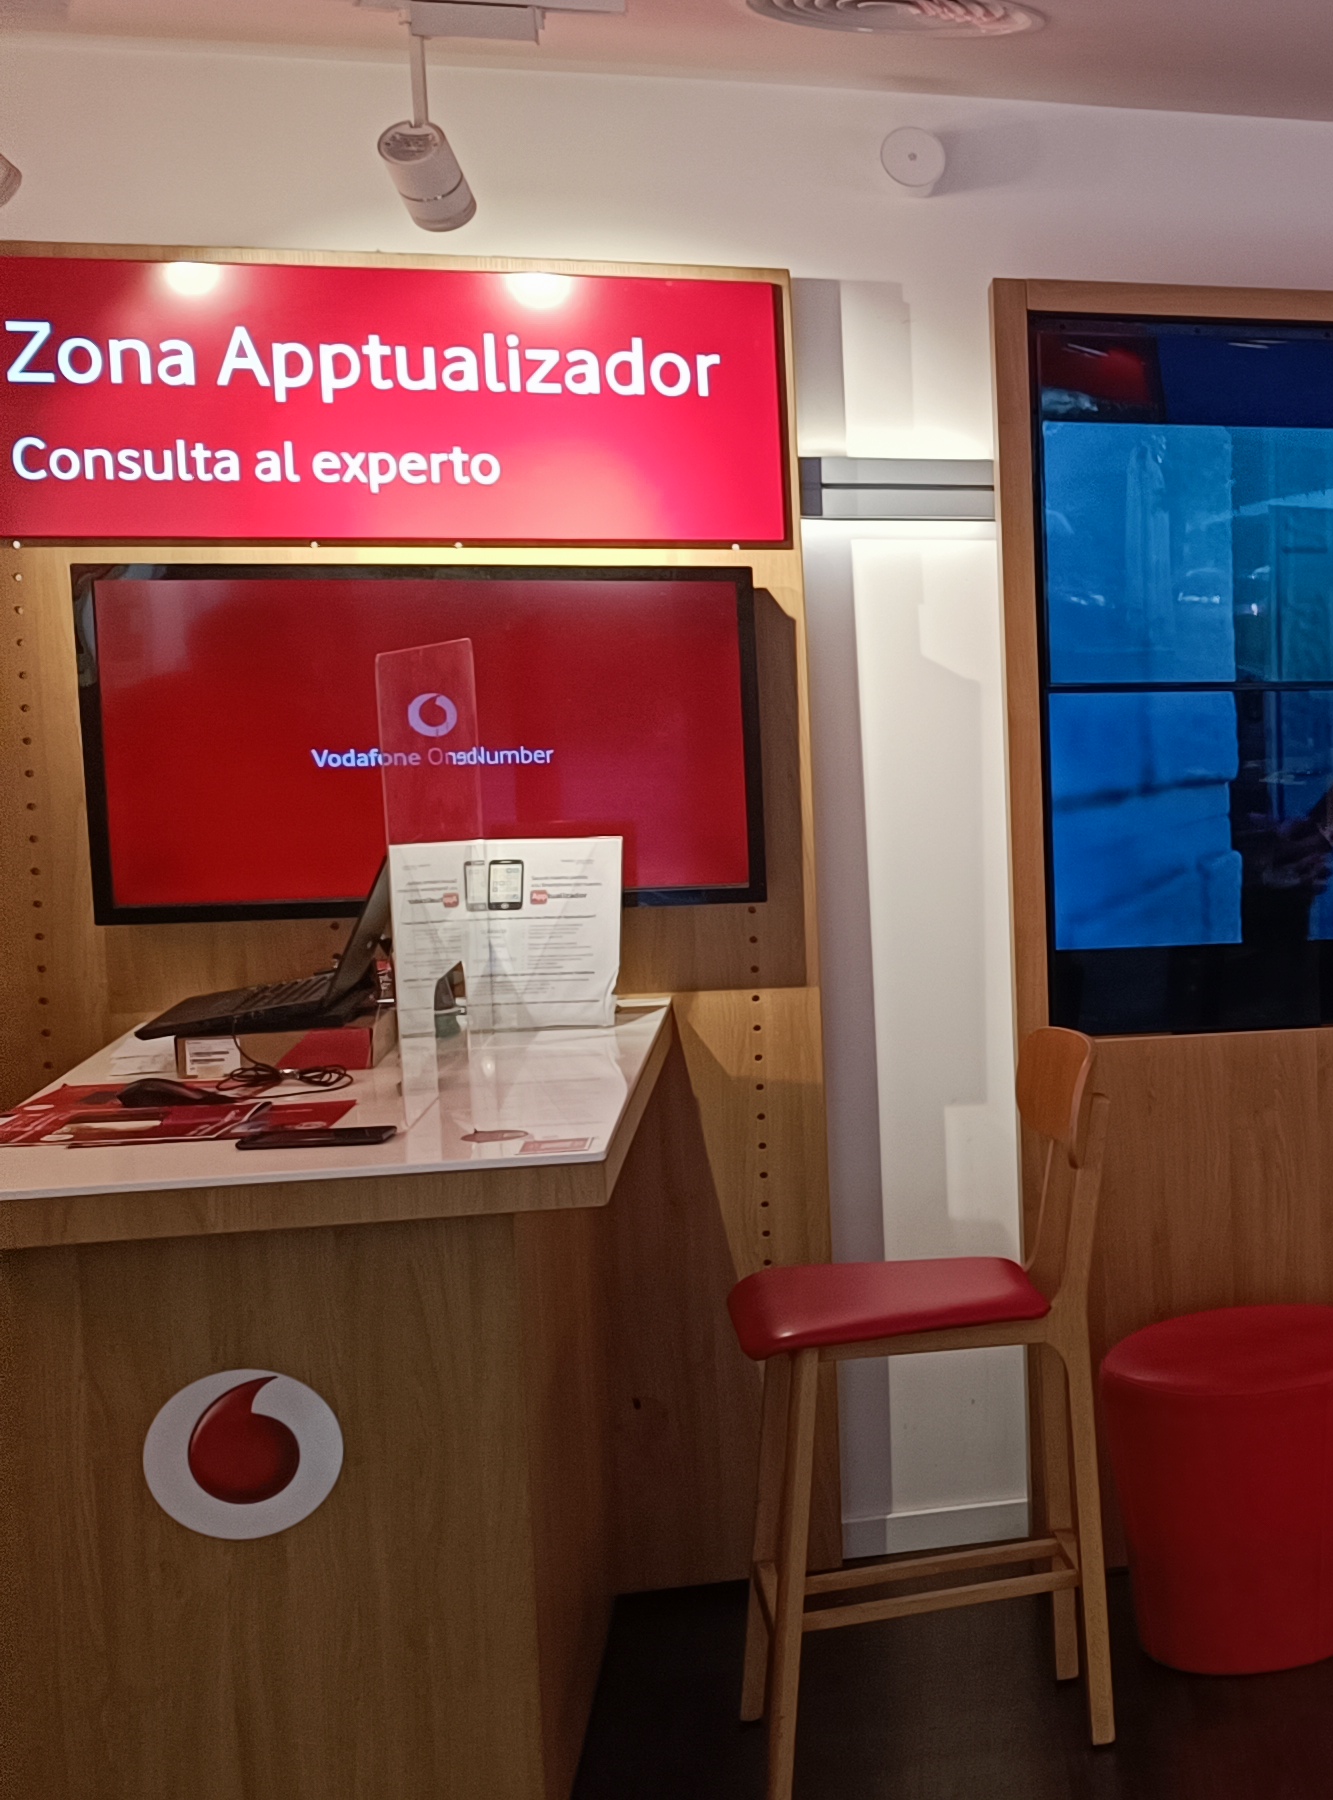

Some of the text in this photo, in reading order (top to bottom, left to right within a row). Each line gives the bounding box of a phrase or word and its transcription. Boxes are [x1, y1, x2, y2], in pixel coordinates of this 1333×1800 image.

[4, 319, 722, 404] Zona Apptualizador
[11, 436, 502, 494] Consulta al experto
[311, 747, 422, 768] Vodafone
